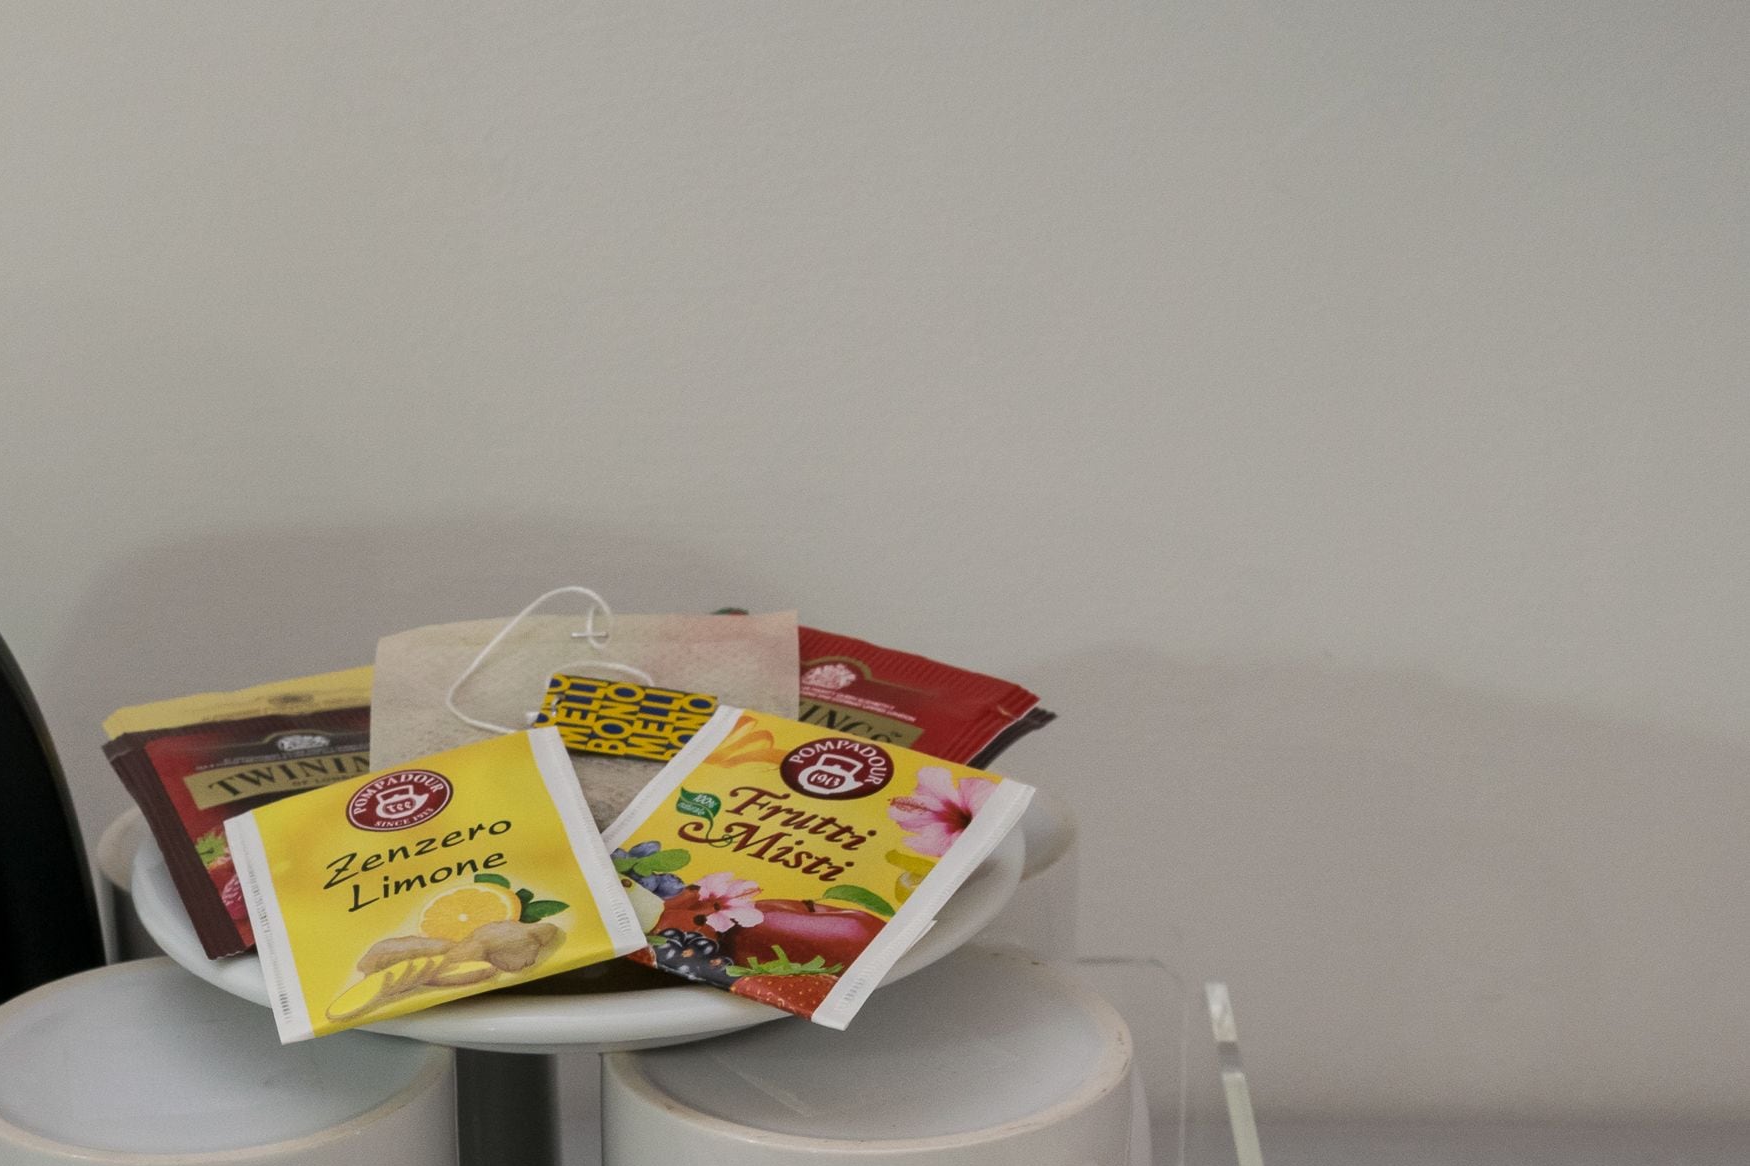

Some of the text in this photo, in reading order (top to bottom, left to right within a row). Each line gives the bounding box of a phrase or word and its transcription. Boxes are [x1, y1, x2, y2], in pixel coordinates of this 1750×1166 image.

[586, 682, 646, 755] BONO
[627, 689, 685, 761] MELLI
[789, 740, 888, 785] POMPADOUR
[810, 772, 841, 787] 1913
[353, 773, 445, 815] POMPADOUR
[373, 807, 435, 828] SINCE 1913
[725, 786, 877, 851] Frutti
[323, 820, 512, 890] Zenzero
[677, 821, 855, 882] Misti
[348, 852, 508, 912] Limone
